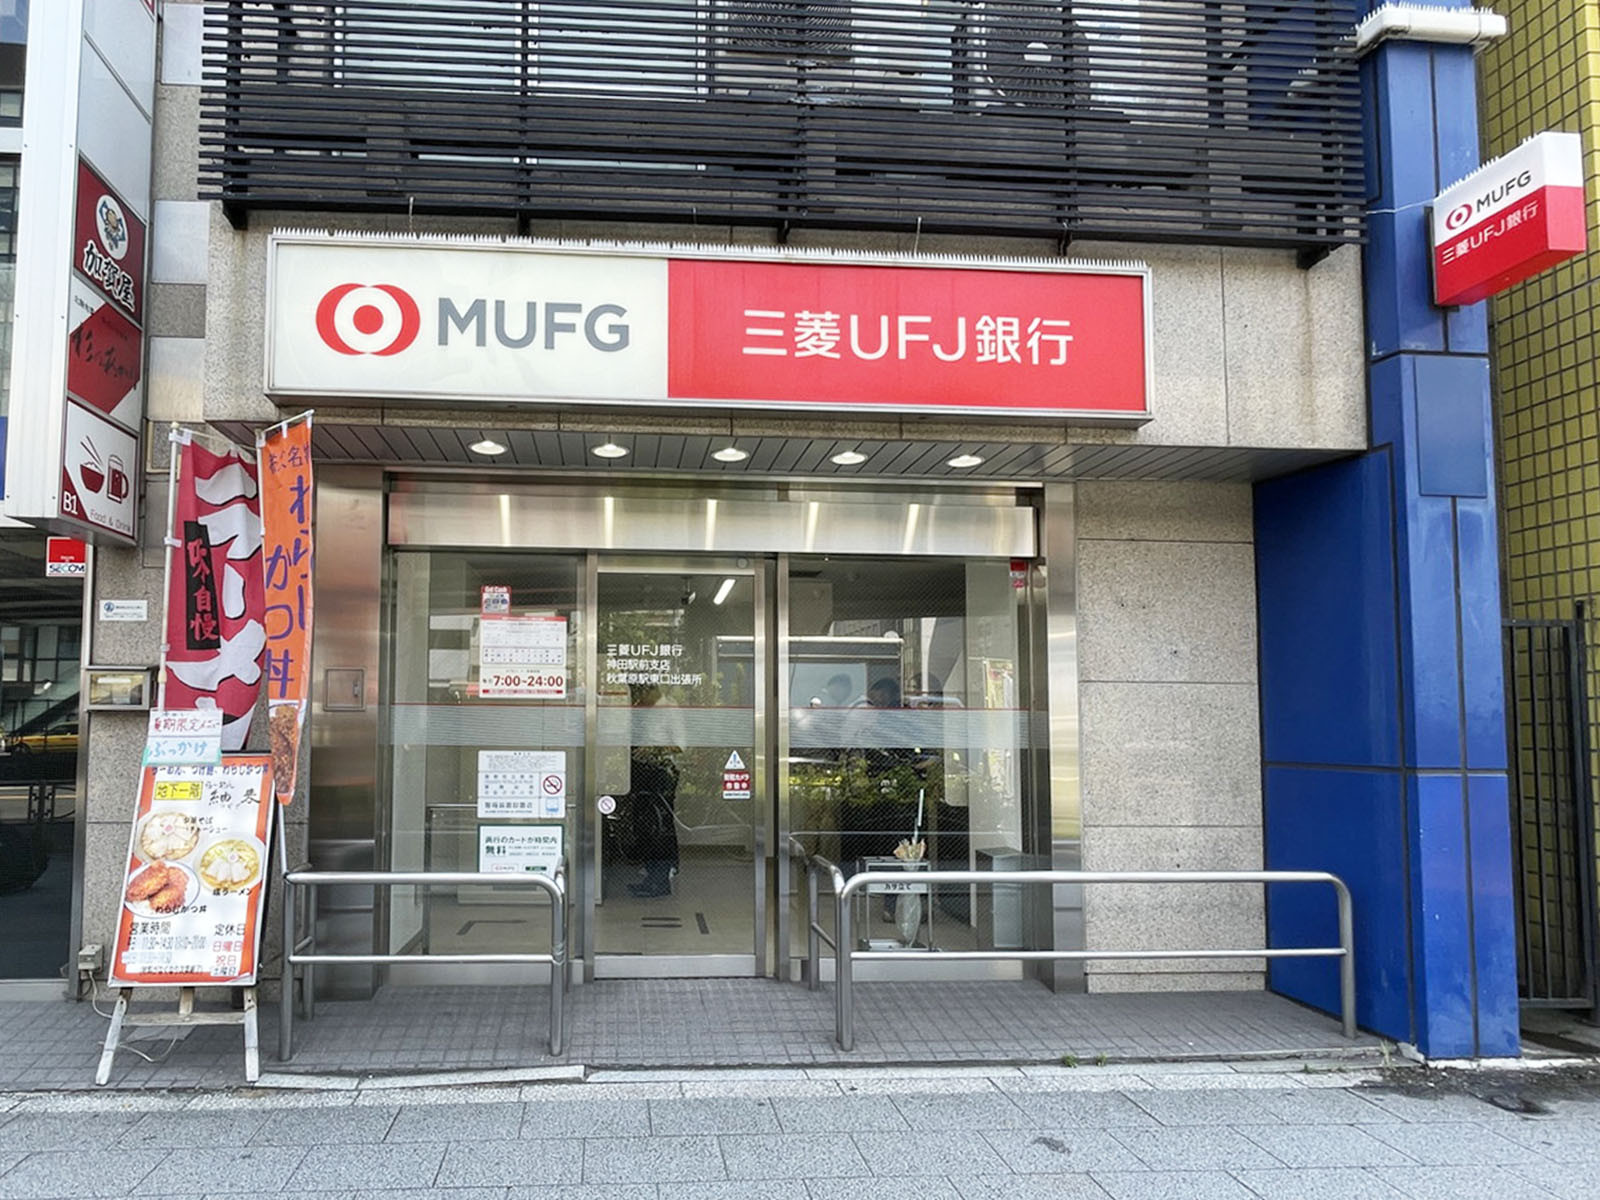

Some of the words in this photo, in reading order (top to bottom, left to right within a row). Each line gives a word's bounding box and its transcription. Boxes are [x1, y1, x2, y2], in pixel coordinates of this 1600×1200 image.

[1476, 170, 1531, 212] MUFG
[1442, 200, 1539, 265] 三菱UFJ銀行
[83, 240, 135, 312] 加賀屋
[438, 297, 630, 353] MUFG
[742, 309, 1074, 366] 三菱UFJ銀行
[63, 491, 78, 515] B1
[90, 509, 107, 524] Food
[108, 518, 114, 526] &
[116, 520, 131, 532] Drink
[49, 563, 85, 573] SECOM
[187, 539, 218, 641] 味自慢
[606, 644, 683, 657] 三菱UFJ銀行
[606, 658, 671, 672] 神田駅前支店
[606, 673, 702, 686] 秋葉原駅東口出張所
[157, 783, 201, 798] 地下一階
[130, 921, 171, 935] 営業時間
[214, 923, 246, 936] 定休日
[212, 941, 243, 952] 日曜日
[216, 955, 237, 966] 祝日
[213, 966, 237, 976] 土曜日
